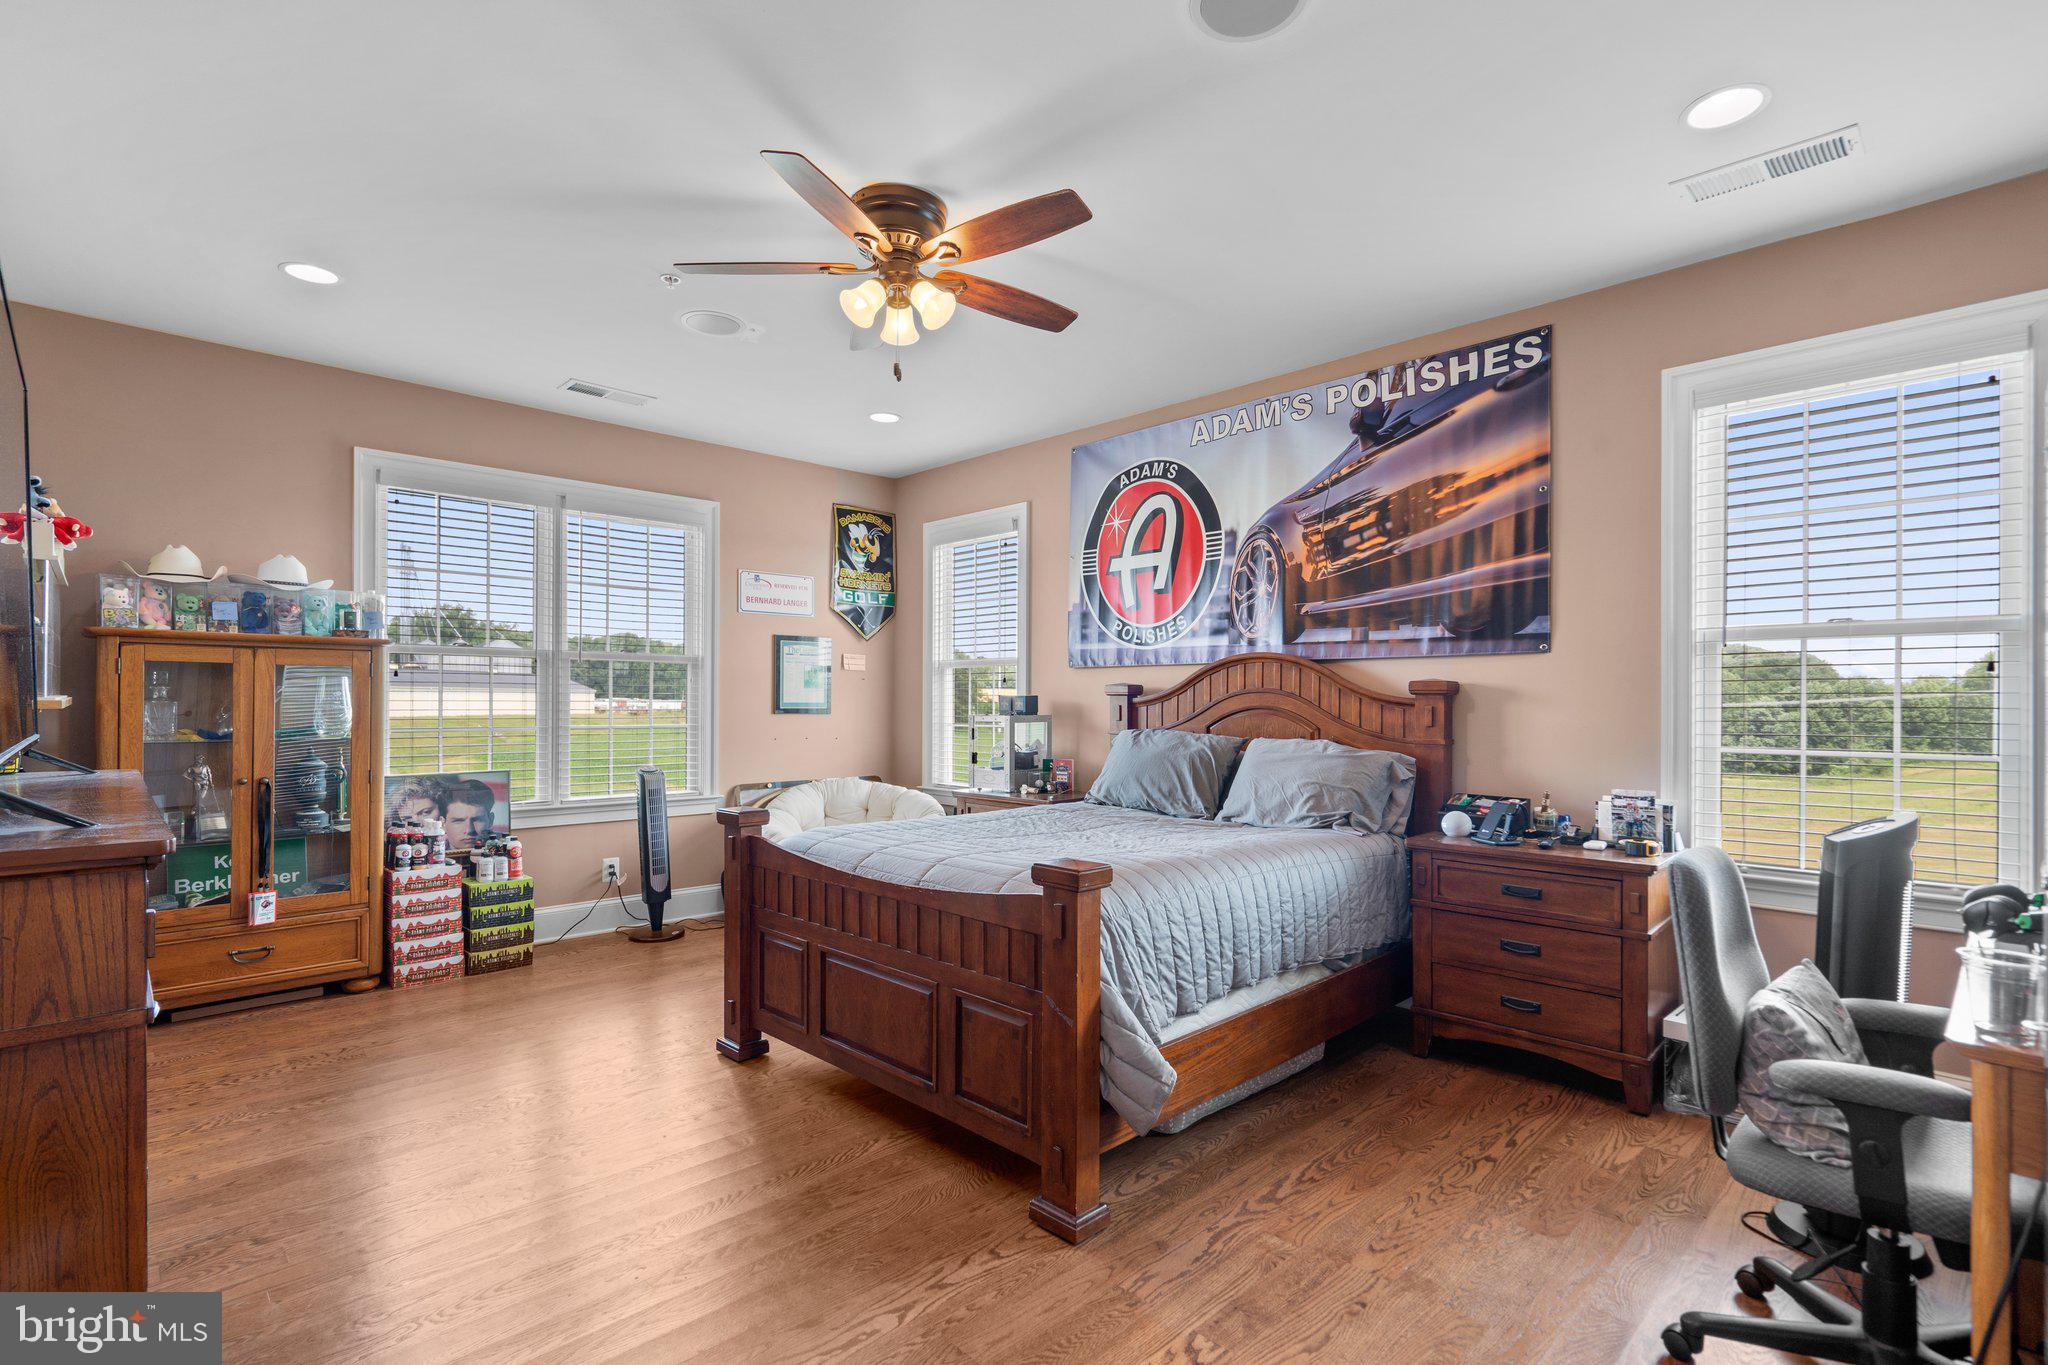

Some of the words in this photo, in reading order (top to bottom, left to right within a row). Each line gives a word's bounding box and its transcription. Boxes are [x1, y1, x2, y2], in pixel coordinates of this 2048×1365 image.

[1190, 393, 1313, 447] ADAM'S
[1325, 335, 1544, 415] POLISHES
[1119, 462, 1179, 489] ADAM'S
[839, 513, 892, 534] DAMASCUS
[839, 577, 892, 591] HORNETS
[745, 595, 782, 606] BERNHARD
[783, 599, 808, 607] LANGER
[842, 591, 889, 605] GOLF
[1111, 615, 1188, 644] POLISHES
